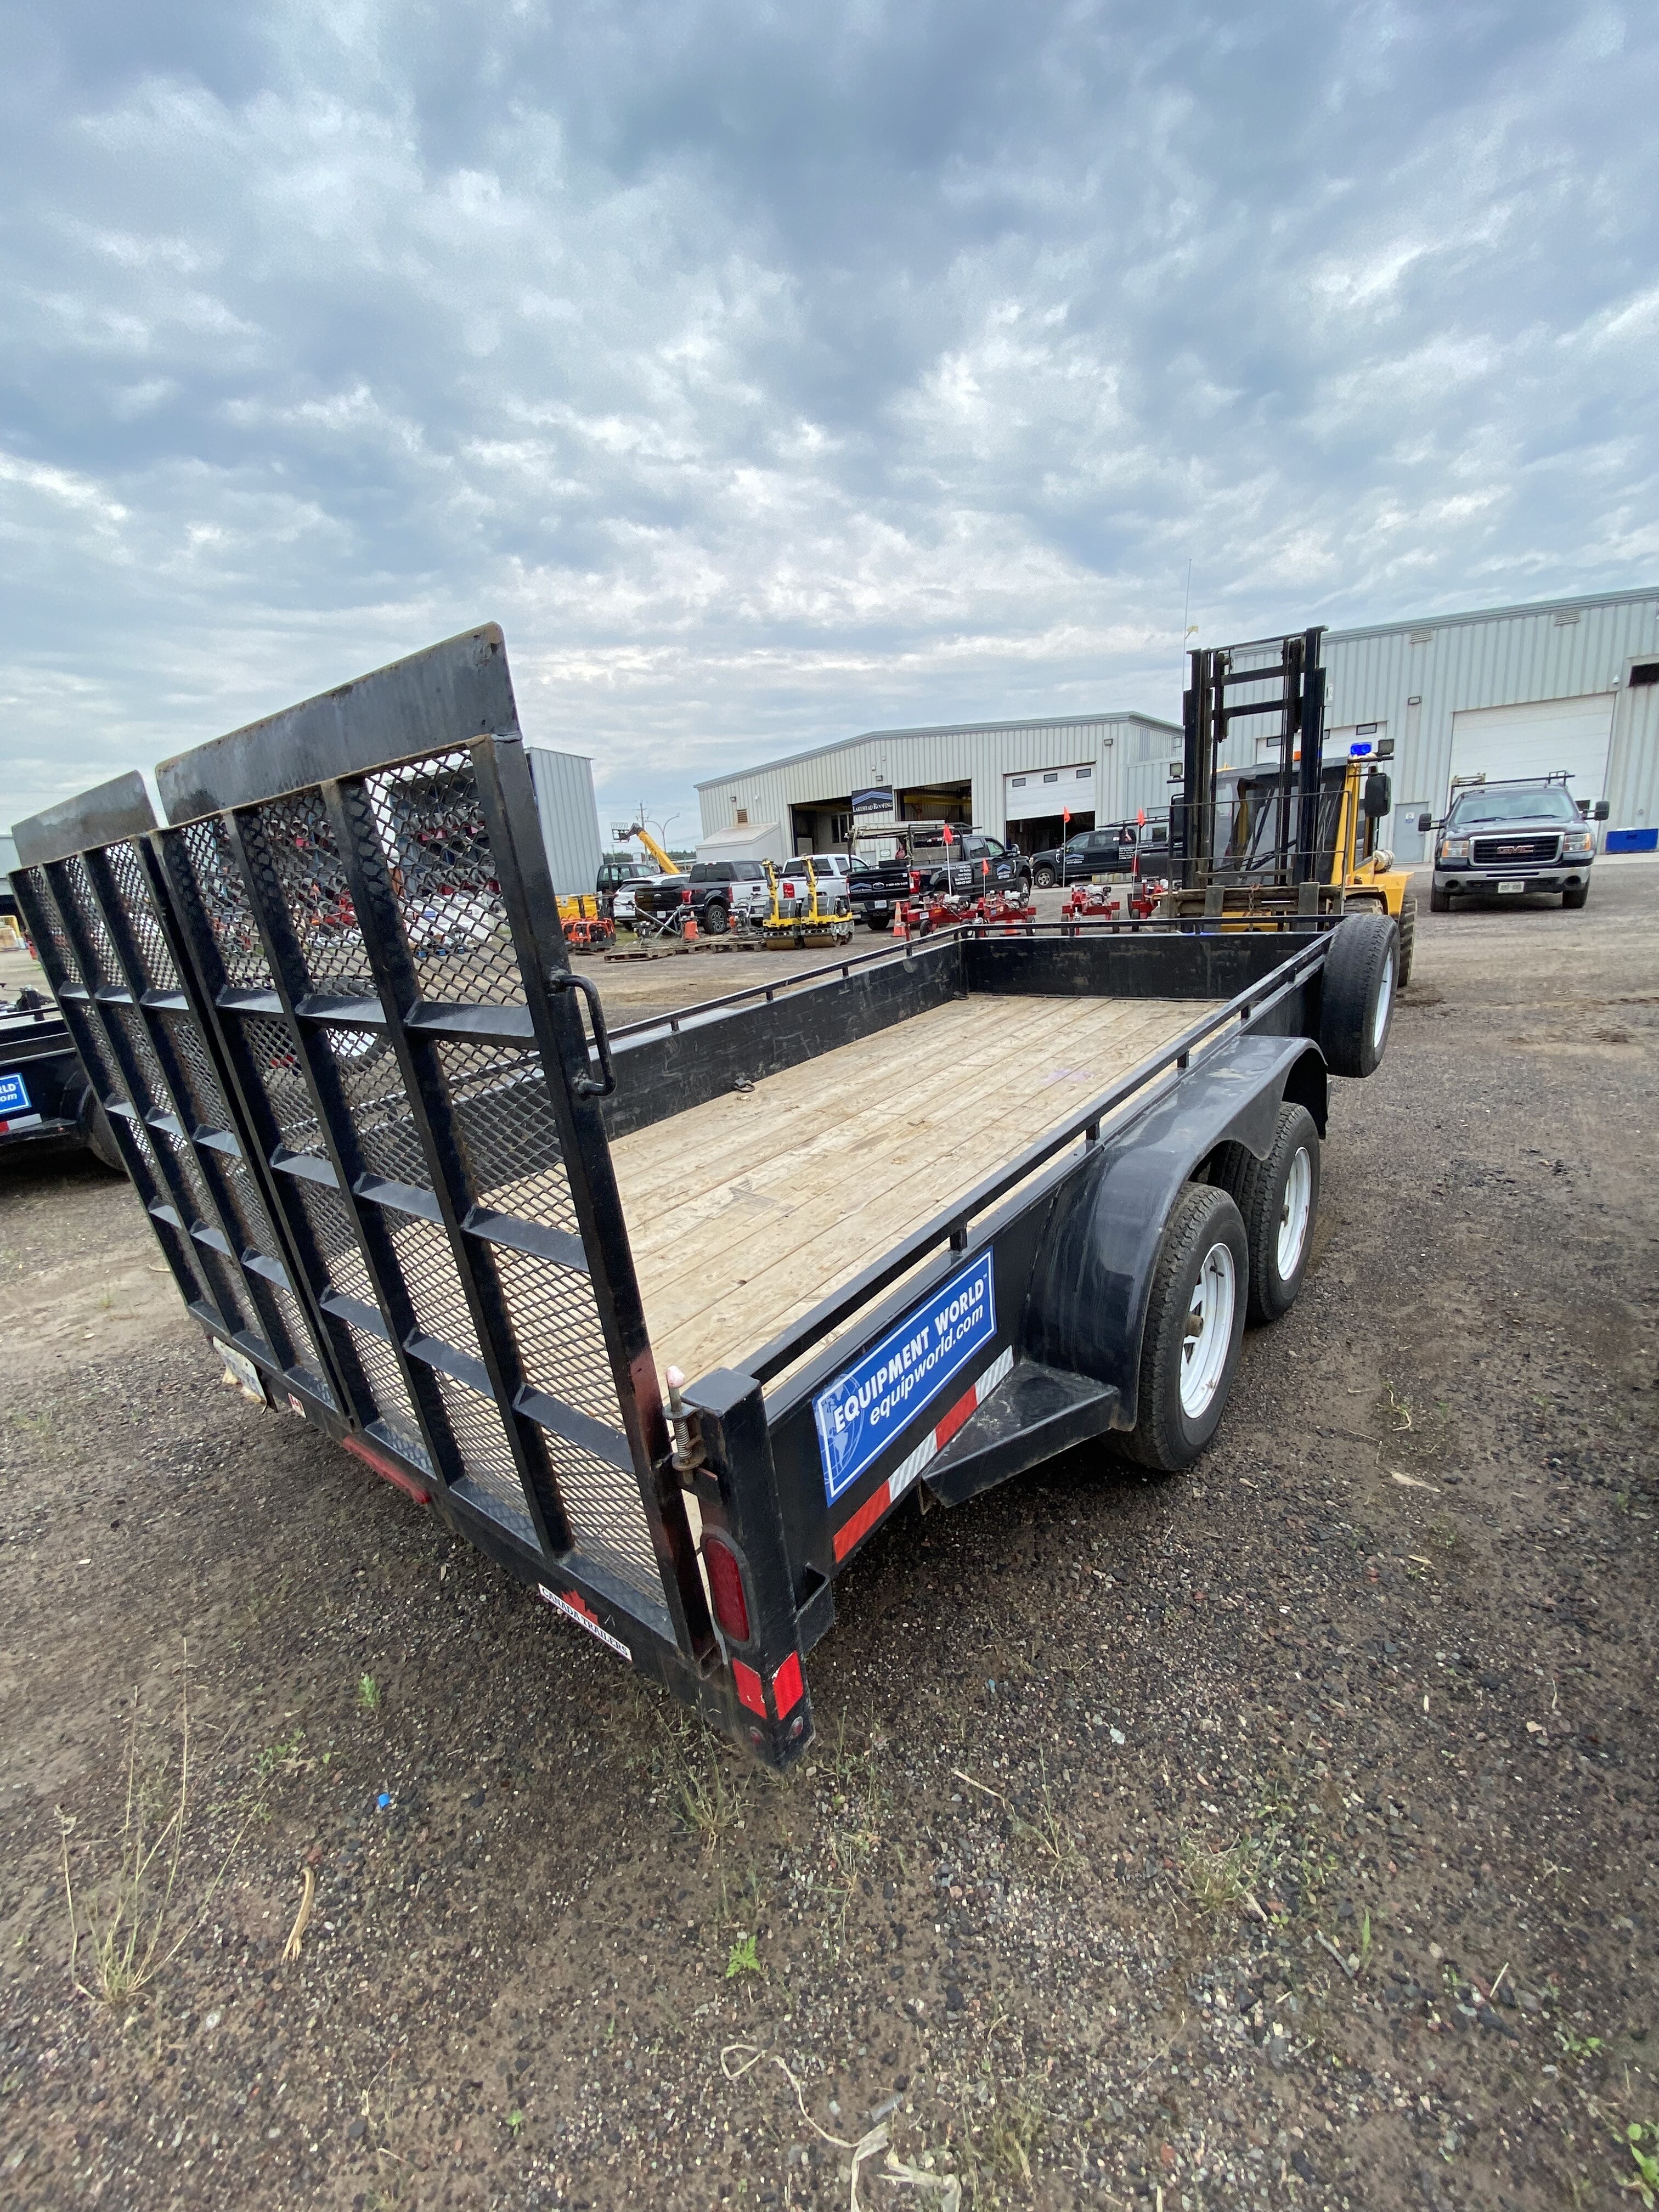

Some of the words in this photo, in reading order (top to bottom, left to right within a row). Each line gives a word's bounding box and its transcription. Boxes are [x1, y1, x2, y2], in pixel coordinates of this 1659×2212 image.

[1497, 845, 1534, 854] GMC
[833, 1325, 929, 1434] EQUIPMENT
[934, 1278, 984, 1335] WORLD
[870, 1304, 984, 1425] equipworld.com
[542, 1588, 580, 1621] CANADA
[581, 1615, 628, 1656] TRAILERS
